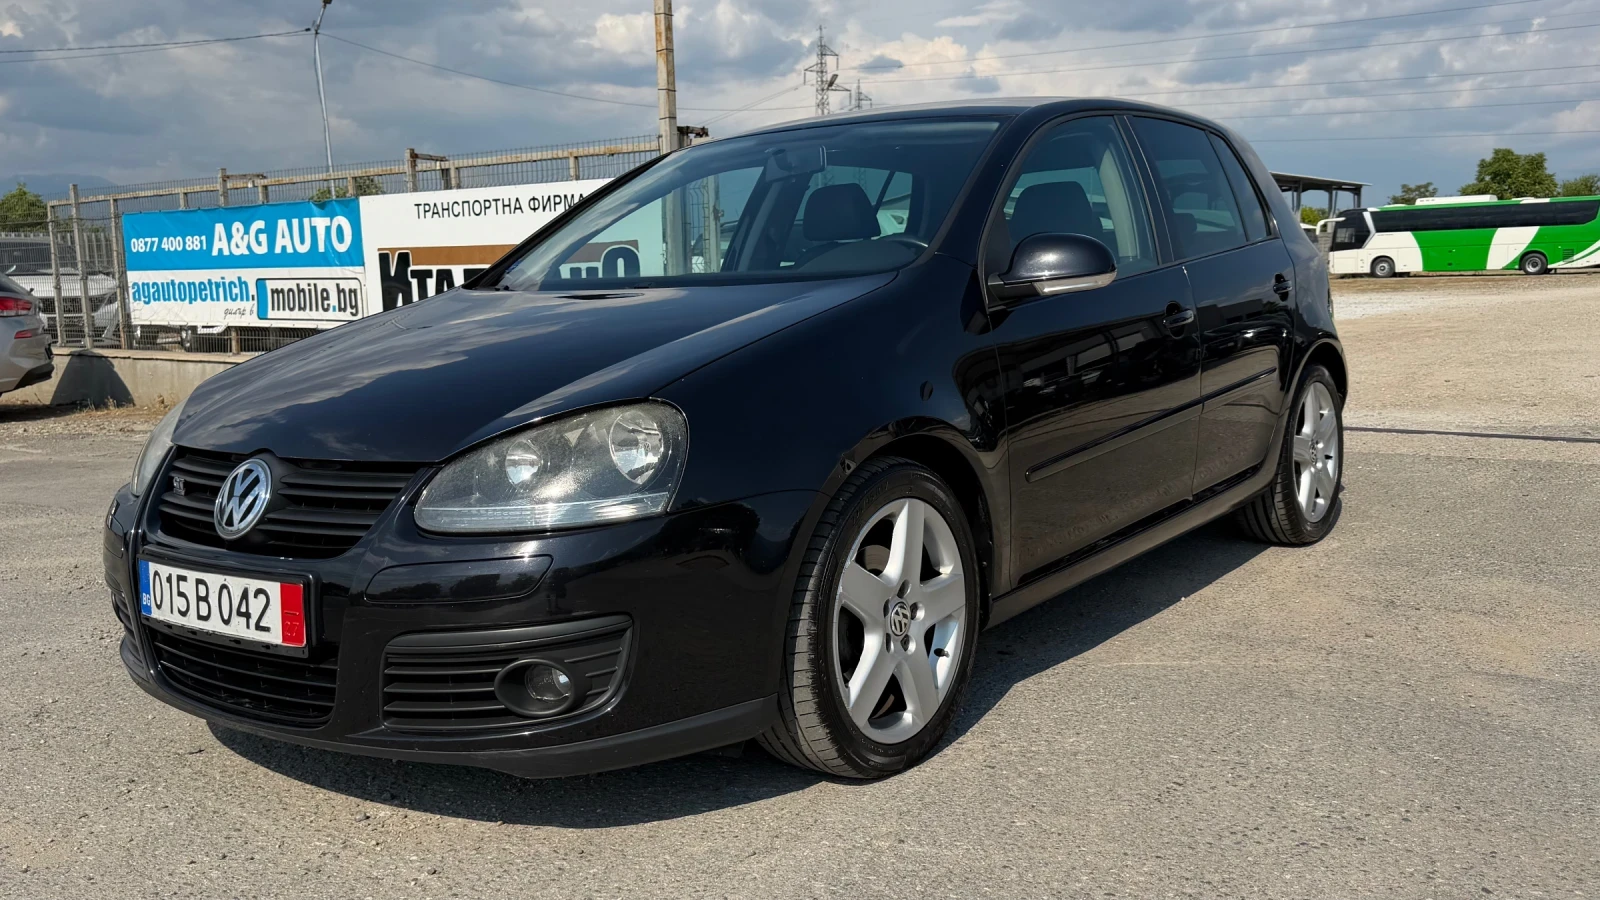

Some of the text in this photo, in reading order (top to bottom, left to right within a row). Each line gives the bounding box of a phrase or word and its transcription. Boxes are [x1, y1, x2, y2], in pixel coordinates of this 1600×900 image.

[414, 197, 524, 219] ТРАНСПОРТНА
[130, 235, 207, 253] 0877 400 881
[211, 215, 353, 257] A&G AUTO
[270, 283, 359, 317] mobile.bg
[142, 592, 151, 606] BG
